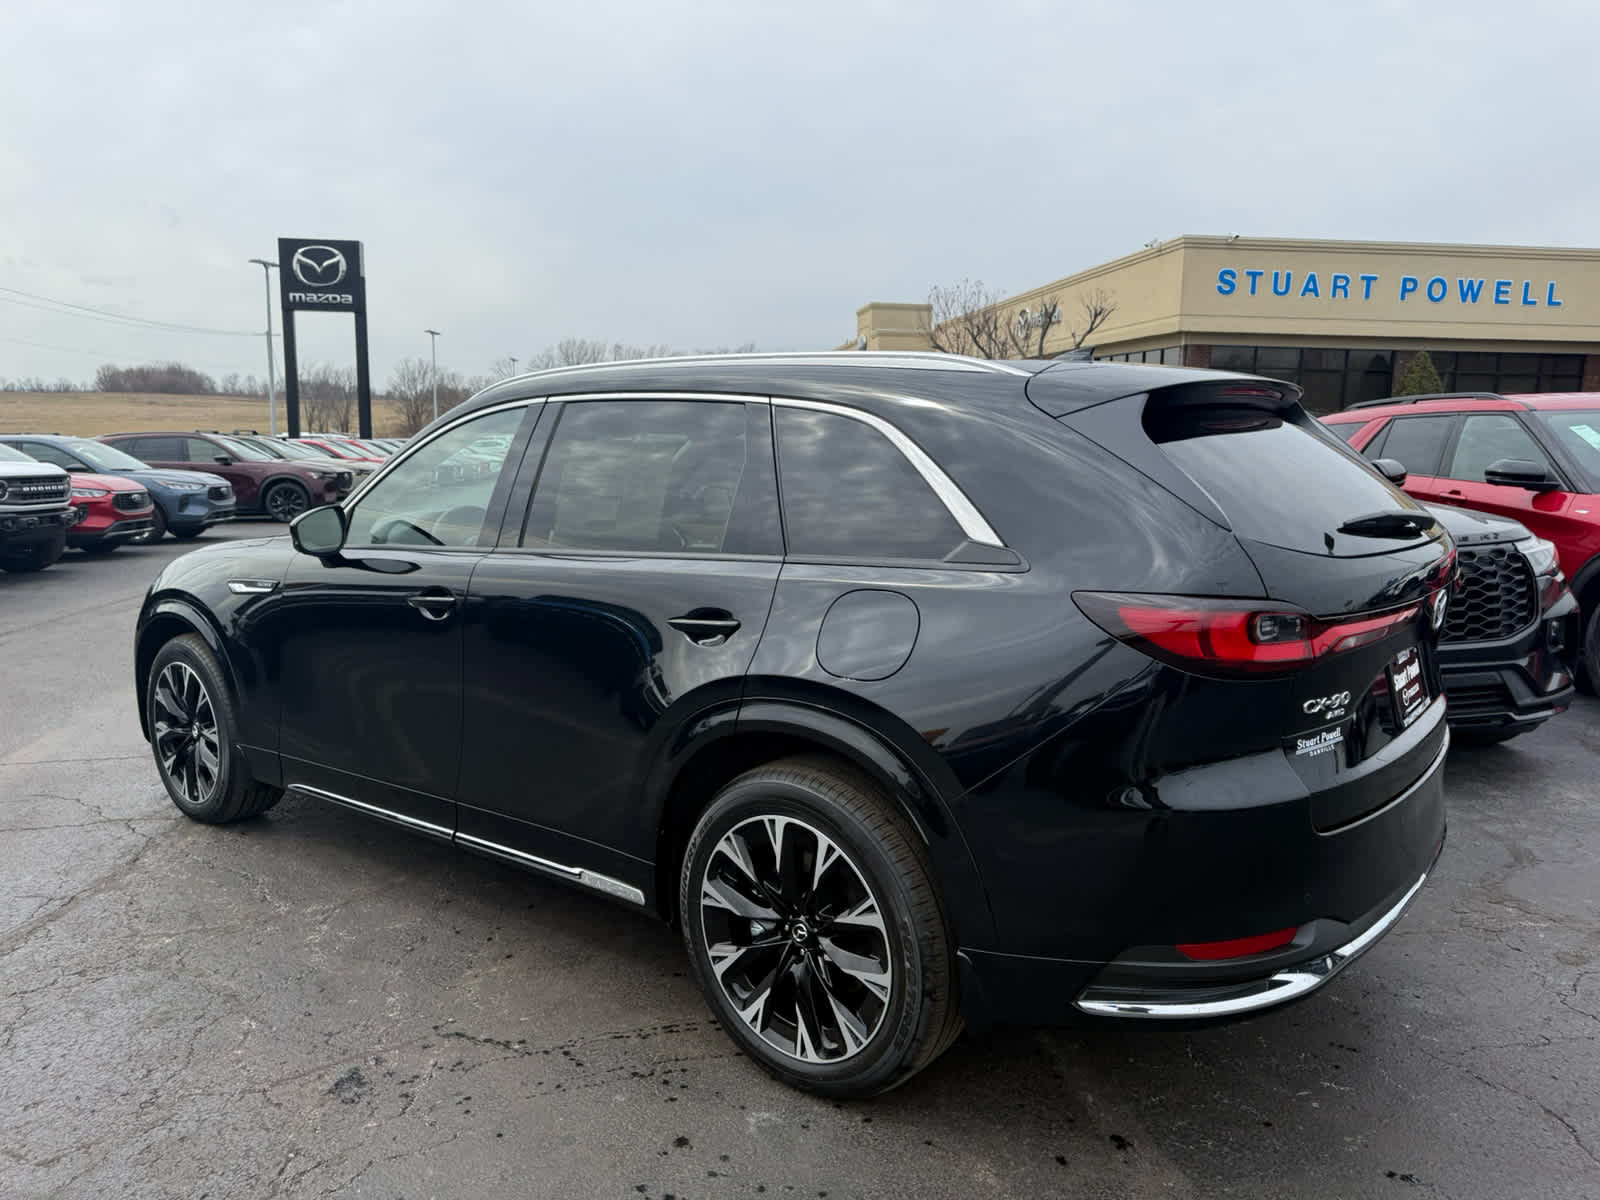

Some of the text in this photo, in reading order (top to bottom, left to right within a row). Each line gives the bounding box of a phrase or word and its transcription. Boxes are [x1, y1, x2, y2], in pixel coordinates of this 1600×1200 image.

[1216, 268, 1563, 307] STUART POWELL
[1303, 690, 1352, 714] CX-90
[1296, 735, 1320, 750] Stuart
